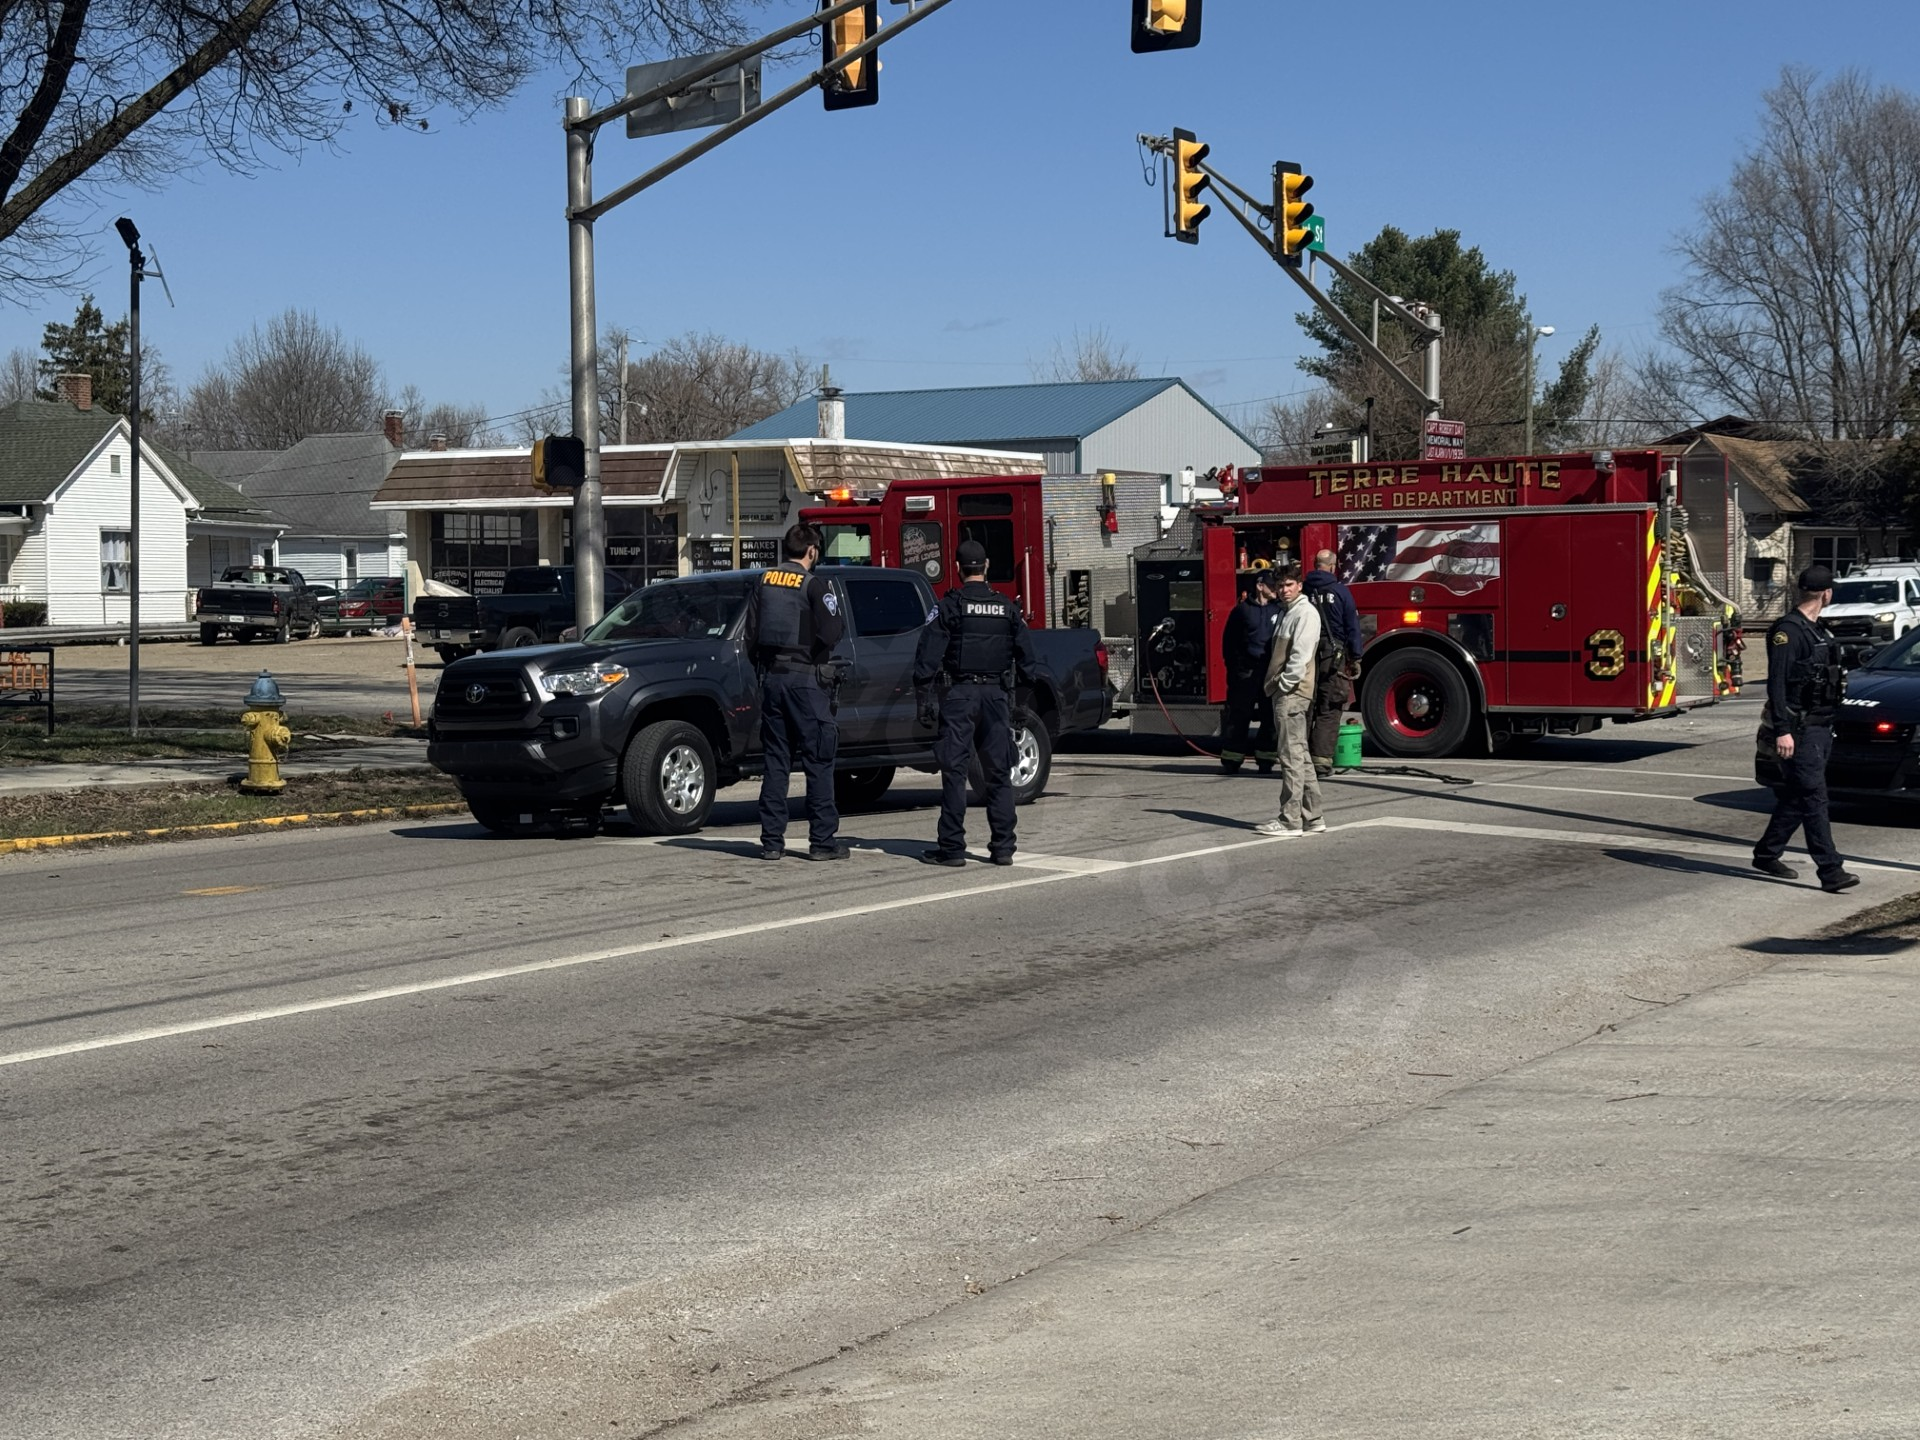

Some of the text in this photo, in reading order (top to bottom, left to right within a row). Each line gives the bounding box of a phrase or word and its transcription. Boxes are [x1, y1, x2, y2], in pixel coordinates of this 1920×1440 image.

[1315, 225, 1323, 243] St
[1427, 435, 1463, 447] MEMORIAL WAY
[1309, 461, 1561, 497] TERRE HAUTE
[1344, 488, 1517, 509] FIRE DEPARTMENT
[610, 546, 640, 556] TUNE-UP
[742, 541, 775, 550] BRAKES
[434, 570, 468, 579] STEERING
[474, 570, 506, 578] AUTHORIZED
[763, 570, 804, 589] POLICE
[967, 603, 1005, 615] POLICE
[1588, 629, 1625, 678] 3
